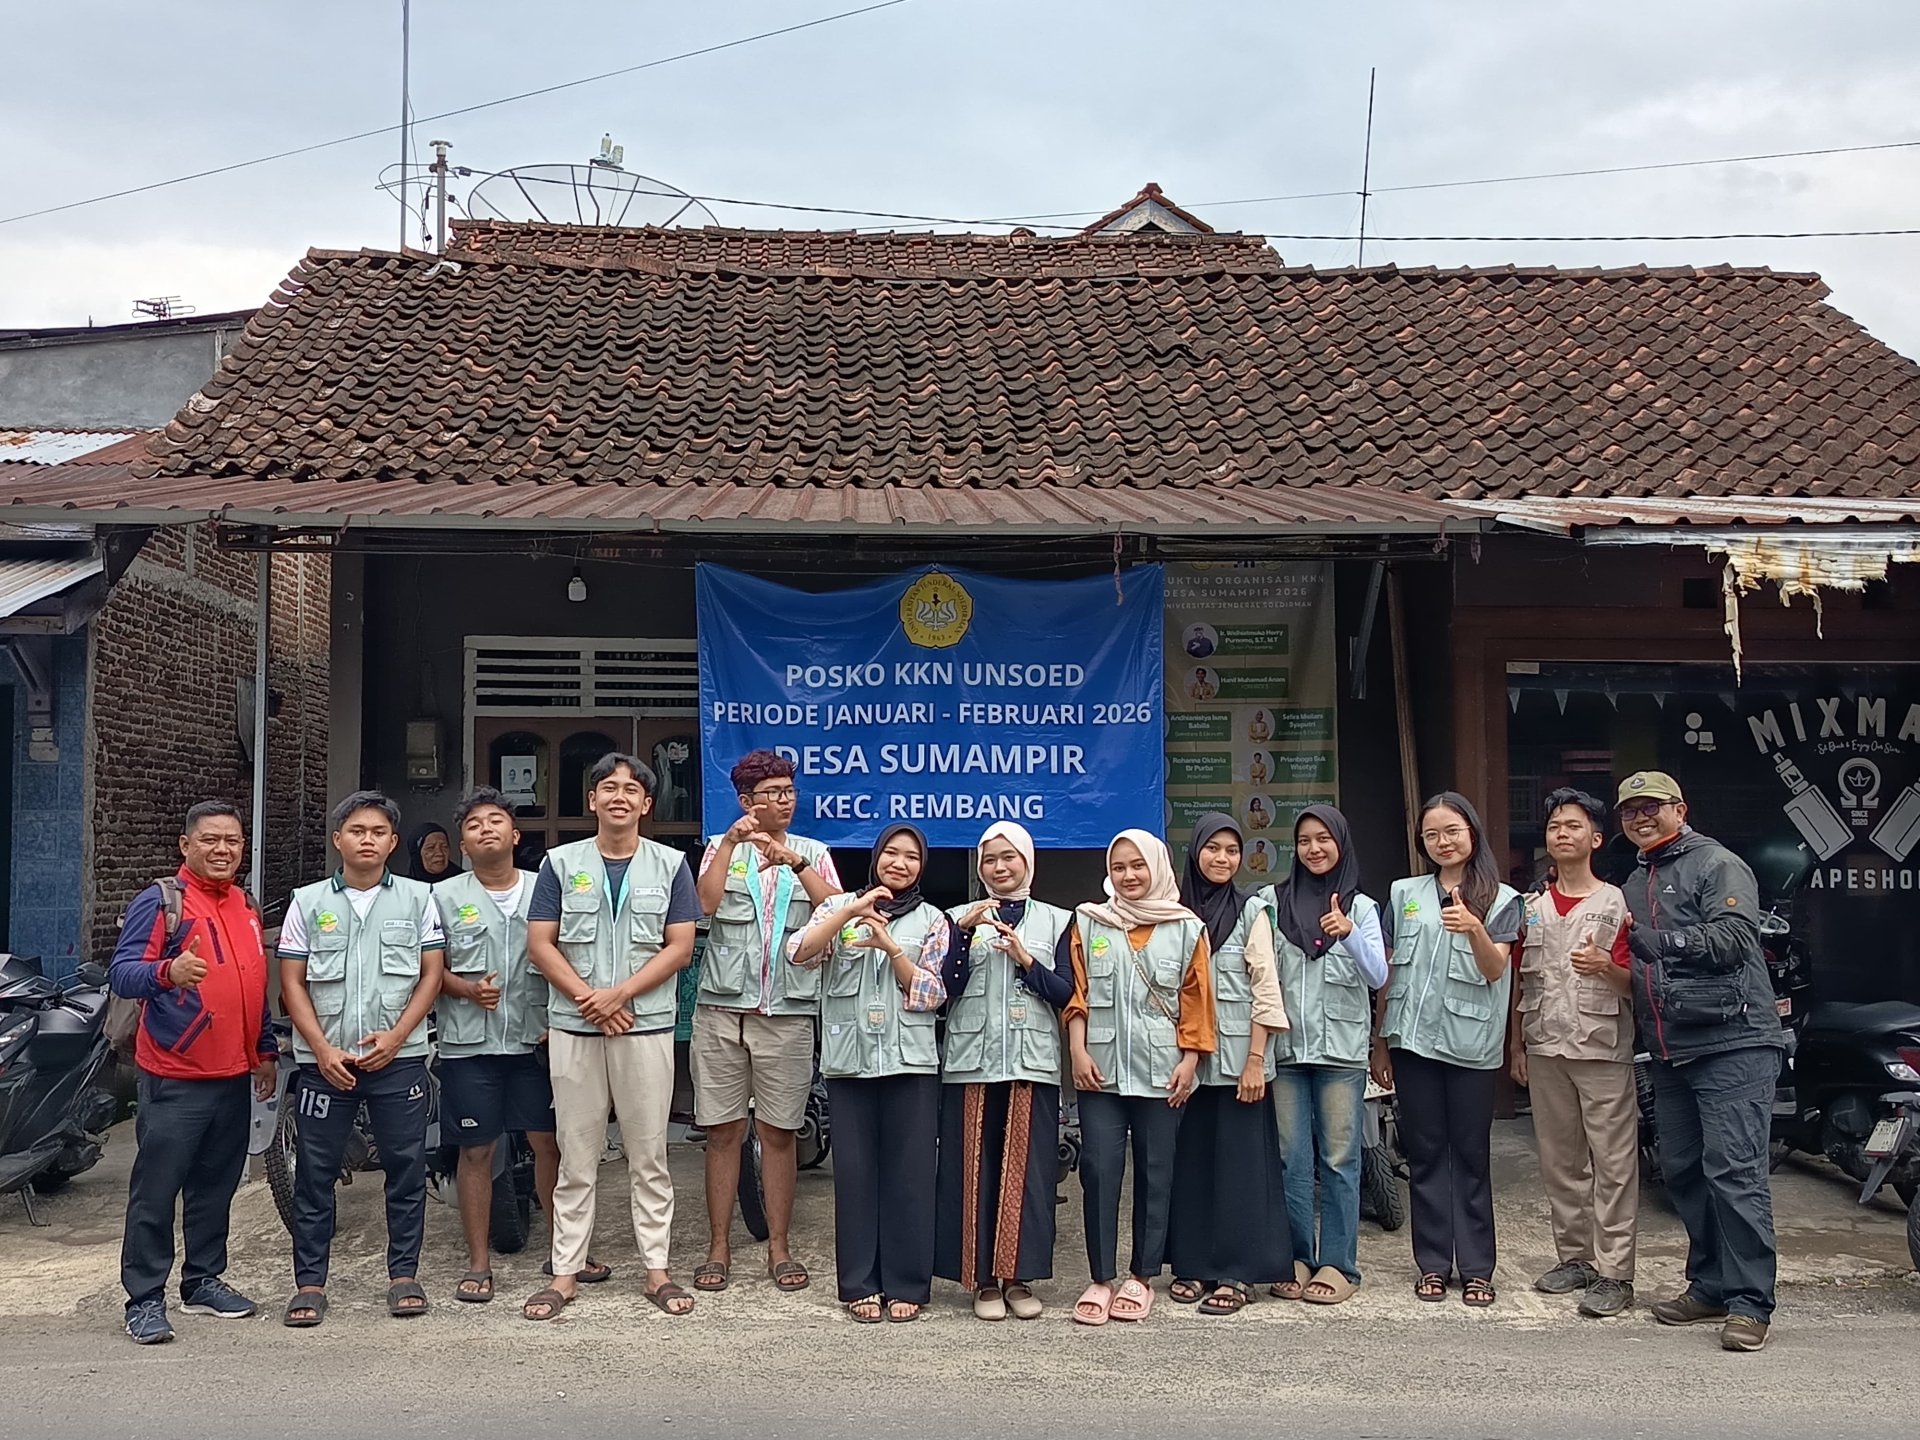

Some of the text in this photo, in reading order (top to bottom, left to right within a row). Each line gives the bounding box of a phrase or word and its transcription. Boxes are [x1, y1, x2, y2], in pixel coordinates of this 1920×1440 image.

[1163, 574, 1324, 585] UKTUR ORGANISASI KKN
[1163, 587, 1307, 597] DESA SUMAMPIR 2026
[906, 579, 968, 635] UNIVERSITAS JENDERAL SOEDIRMAN
[786, 662, 1085, 687] POSKO KKN UNSOED
[713, 701, 818, 725] PERIODE
[824, 702, 935, 731] JANUARI
[959, 702, 1084, 725] FEBRUARI
[1092, 701, 1152, 724] 2026
[1851, 739, 1869, 752] Enjoy
[774, 744, 1087, 775] DESA SUMAMPIR
[815, 794, 1045, 819] KEC. REMBANG
[1850, 809, 1869, 818] SINCE
[1811, 868, 1920, 889] APESHO
[299, 1087, 331, 1119] 119
